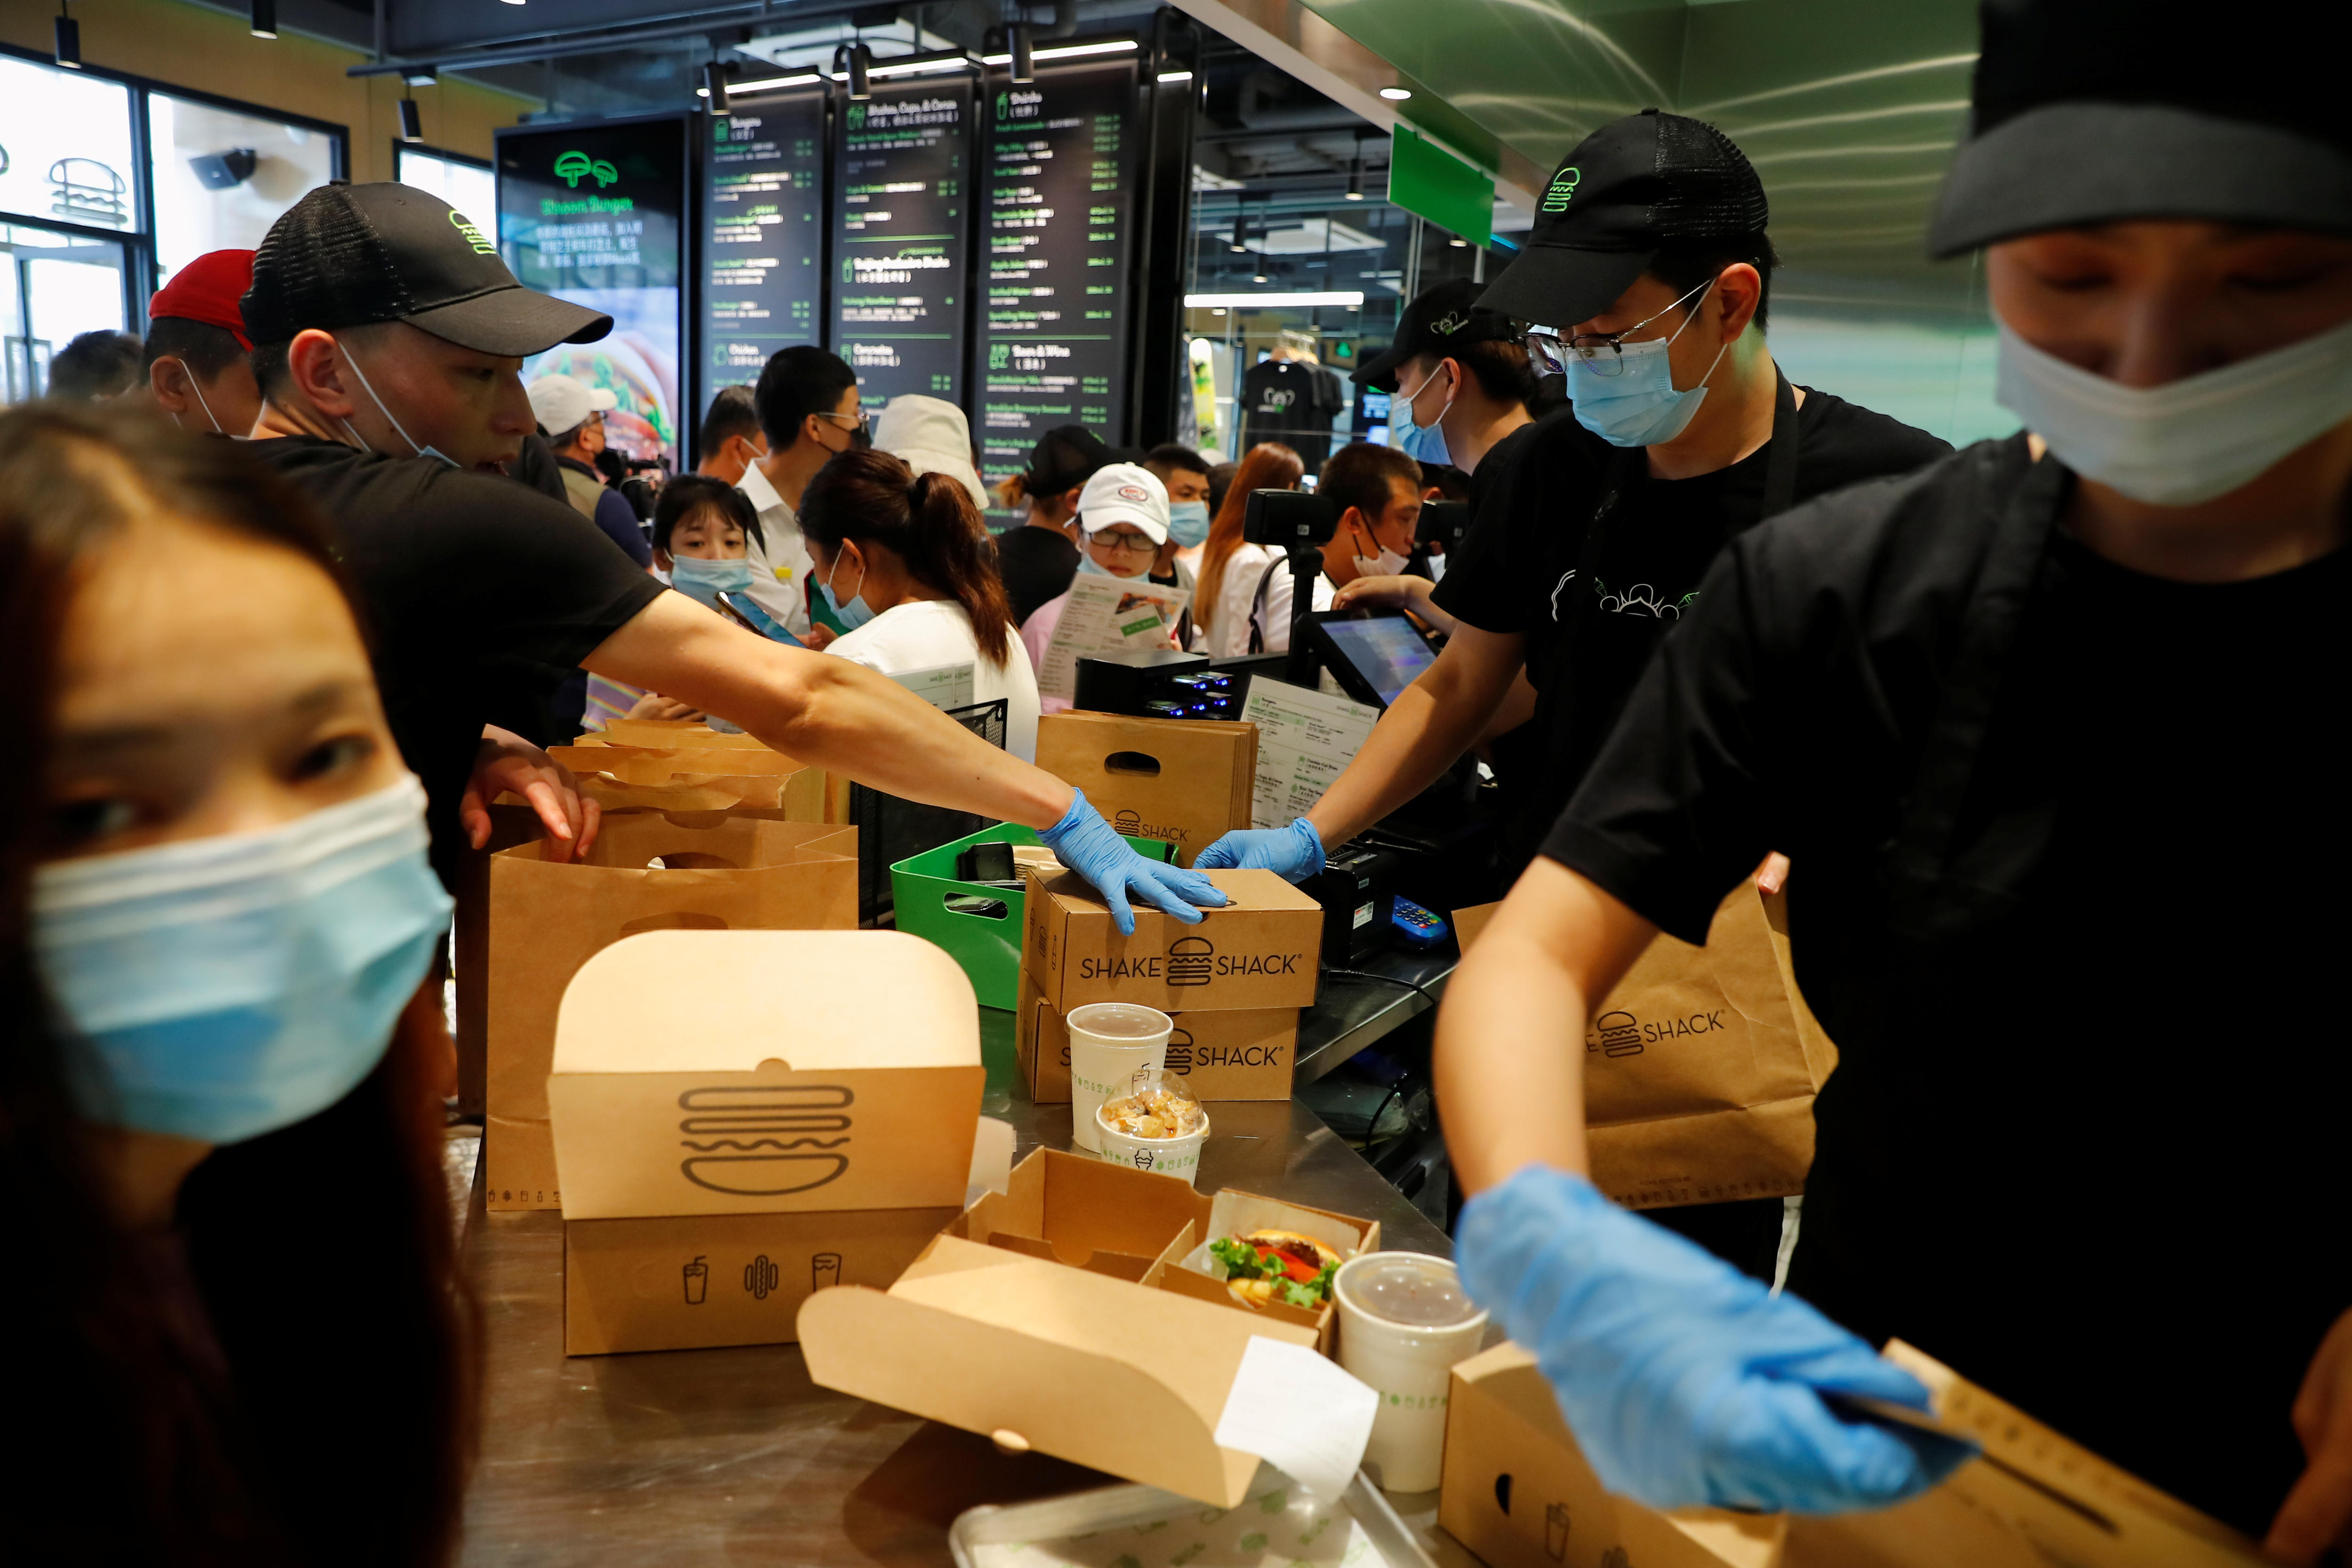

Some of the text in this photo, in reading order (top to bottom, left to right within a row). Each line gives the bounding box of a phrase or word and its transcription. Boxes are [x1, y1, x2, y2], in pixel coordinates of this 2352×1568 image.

[1009, 91, 1042, 105] Drinks
[1012, 344, 1036, 358] Beer
[1080, 957, 1161, 979] SHAKE
